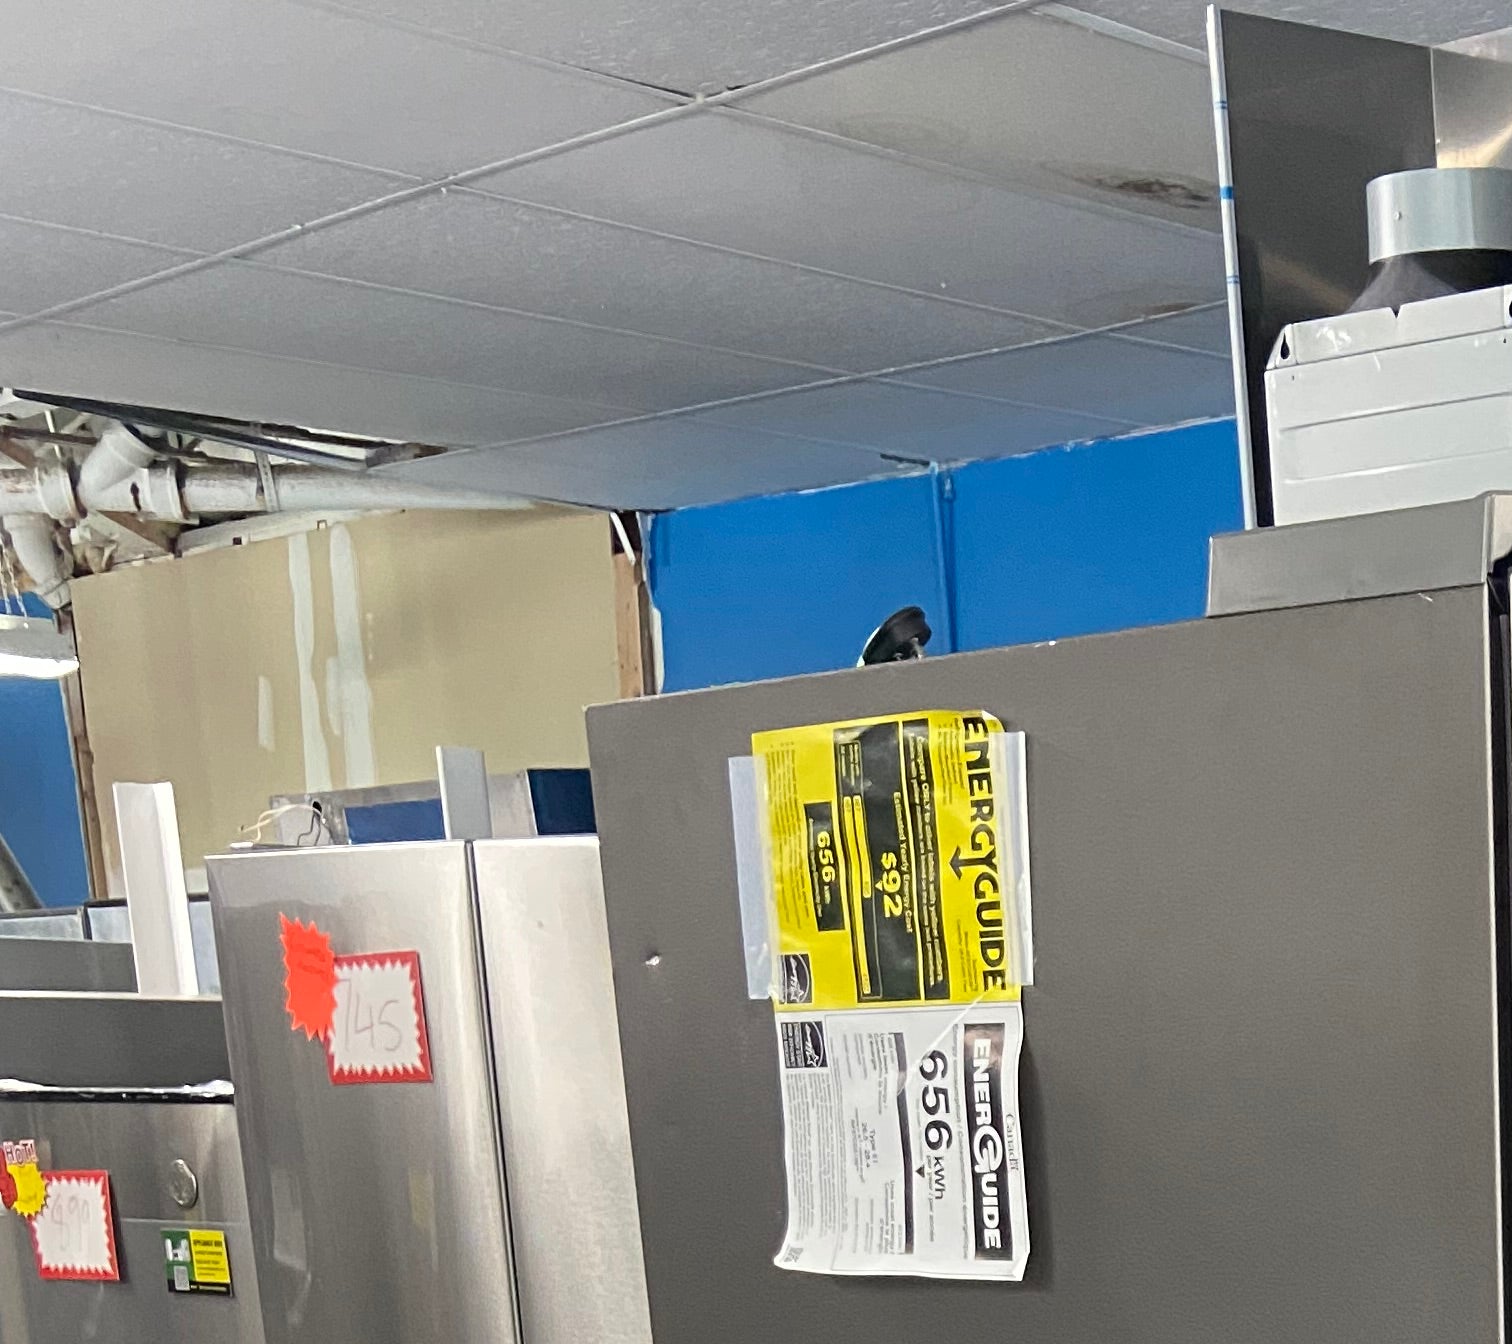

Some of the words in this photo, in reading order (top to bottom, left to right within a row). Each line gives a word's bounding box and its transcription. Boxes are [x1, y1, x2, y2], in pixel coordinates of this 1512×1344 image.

[893, 792, 907, 840] Estimated
[816, 830, 836, 882] 656
[900, 843, 909, 872] Yearly
[962, 718, 1006, 991] ENERGYGUIDE
[881, 852, 902, 918] $92
[902, 874, 910, 908] Energy
[905, 910, 914, 933] Cost
[340, 976, 403, 1055] 745
[919, 1050, 952, 1150] 656
[974, 1038, 1003, 1249] ENERGUIDE
[934, 1156, 946, 1200] kWh
